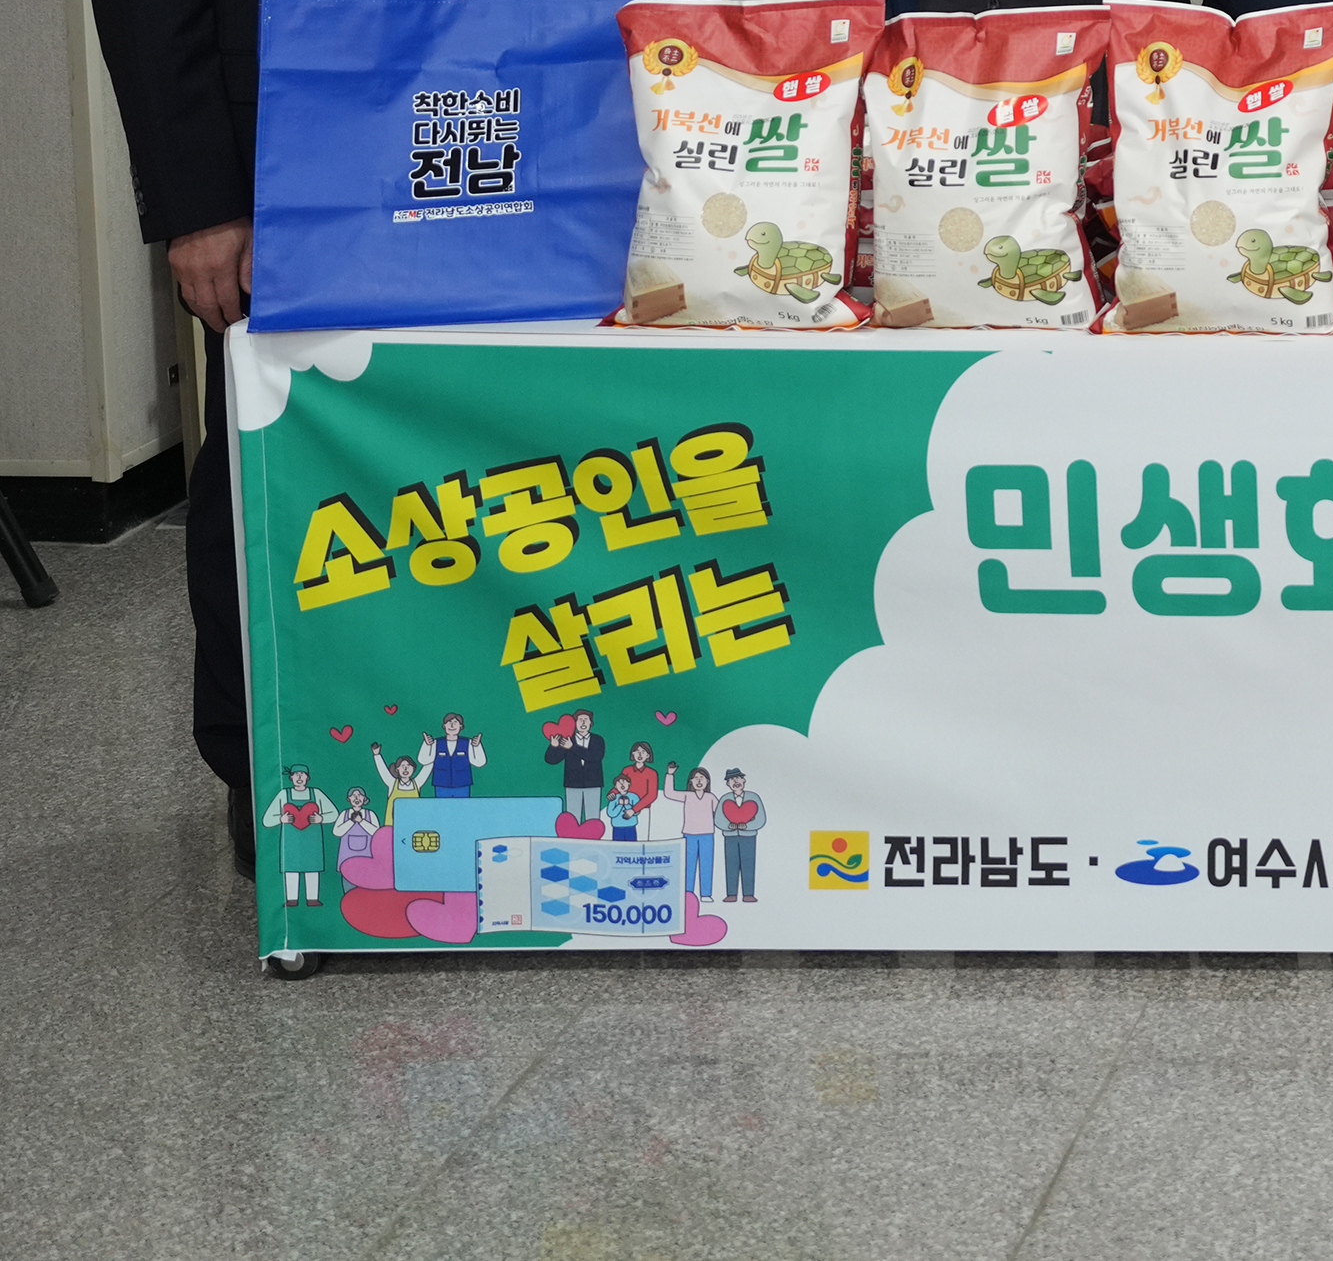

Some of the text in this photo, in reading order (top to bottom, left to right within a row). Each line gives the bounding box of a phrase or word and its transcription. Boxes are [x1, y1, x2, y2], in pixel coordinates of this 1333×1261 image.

[673, 140, 738, 172] 실린
[743, 113, 808, 172] 쌀
[971, 124, 1037, 187] 쌀
[1224, 116, 1290, 179] 쌀
[410, 143, 521, 199] 전남
[905, 158, 967, 187] 실린
[1169, 149, 1219, 179] 실린
[425, 201, 534, 219] 전라남도소상공인연합회
[786, 312, 800, 322] kg
[1035, 316, 1049, 325] kg
[1270, 317, 1293, 327] 5 kg
[293, 422, 772, 611] 소상공인을
[500, 558, 795, 712] 살리는
[883, 836, 1071, 888] 전라남도
[582, 902, 673, 926] 150,000
